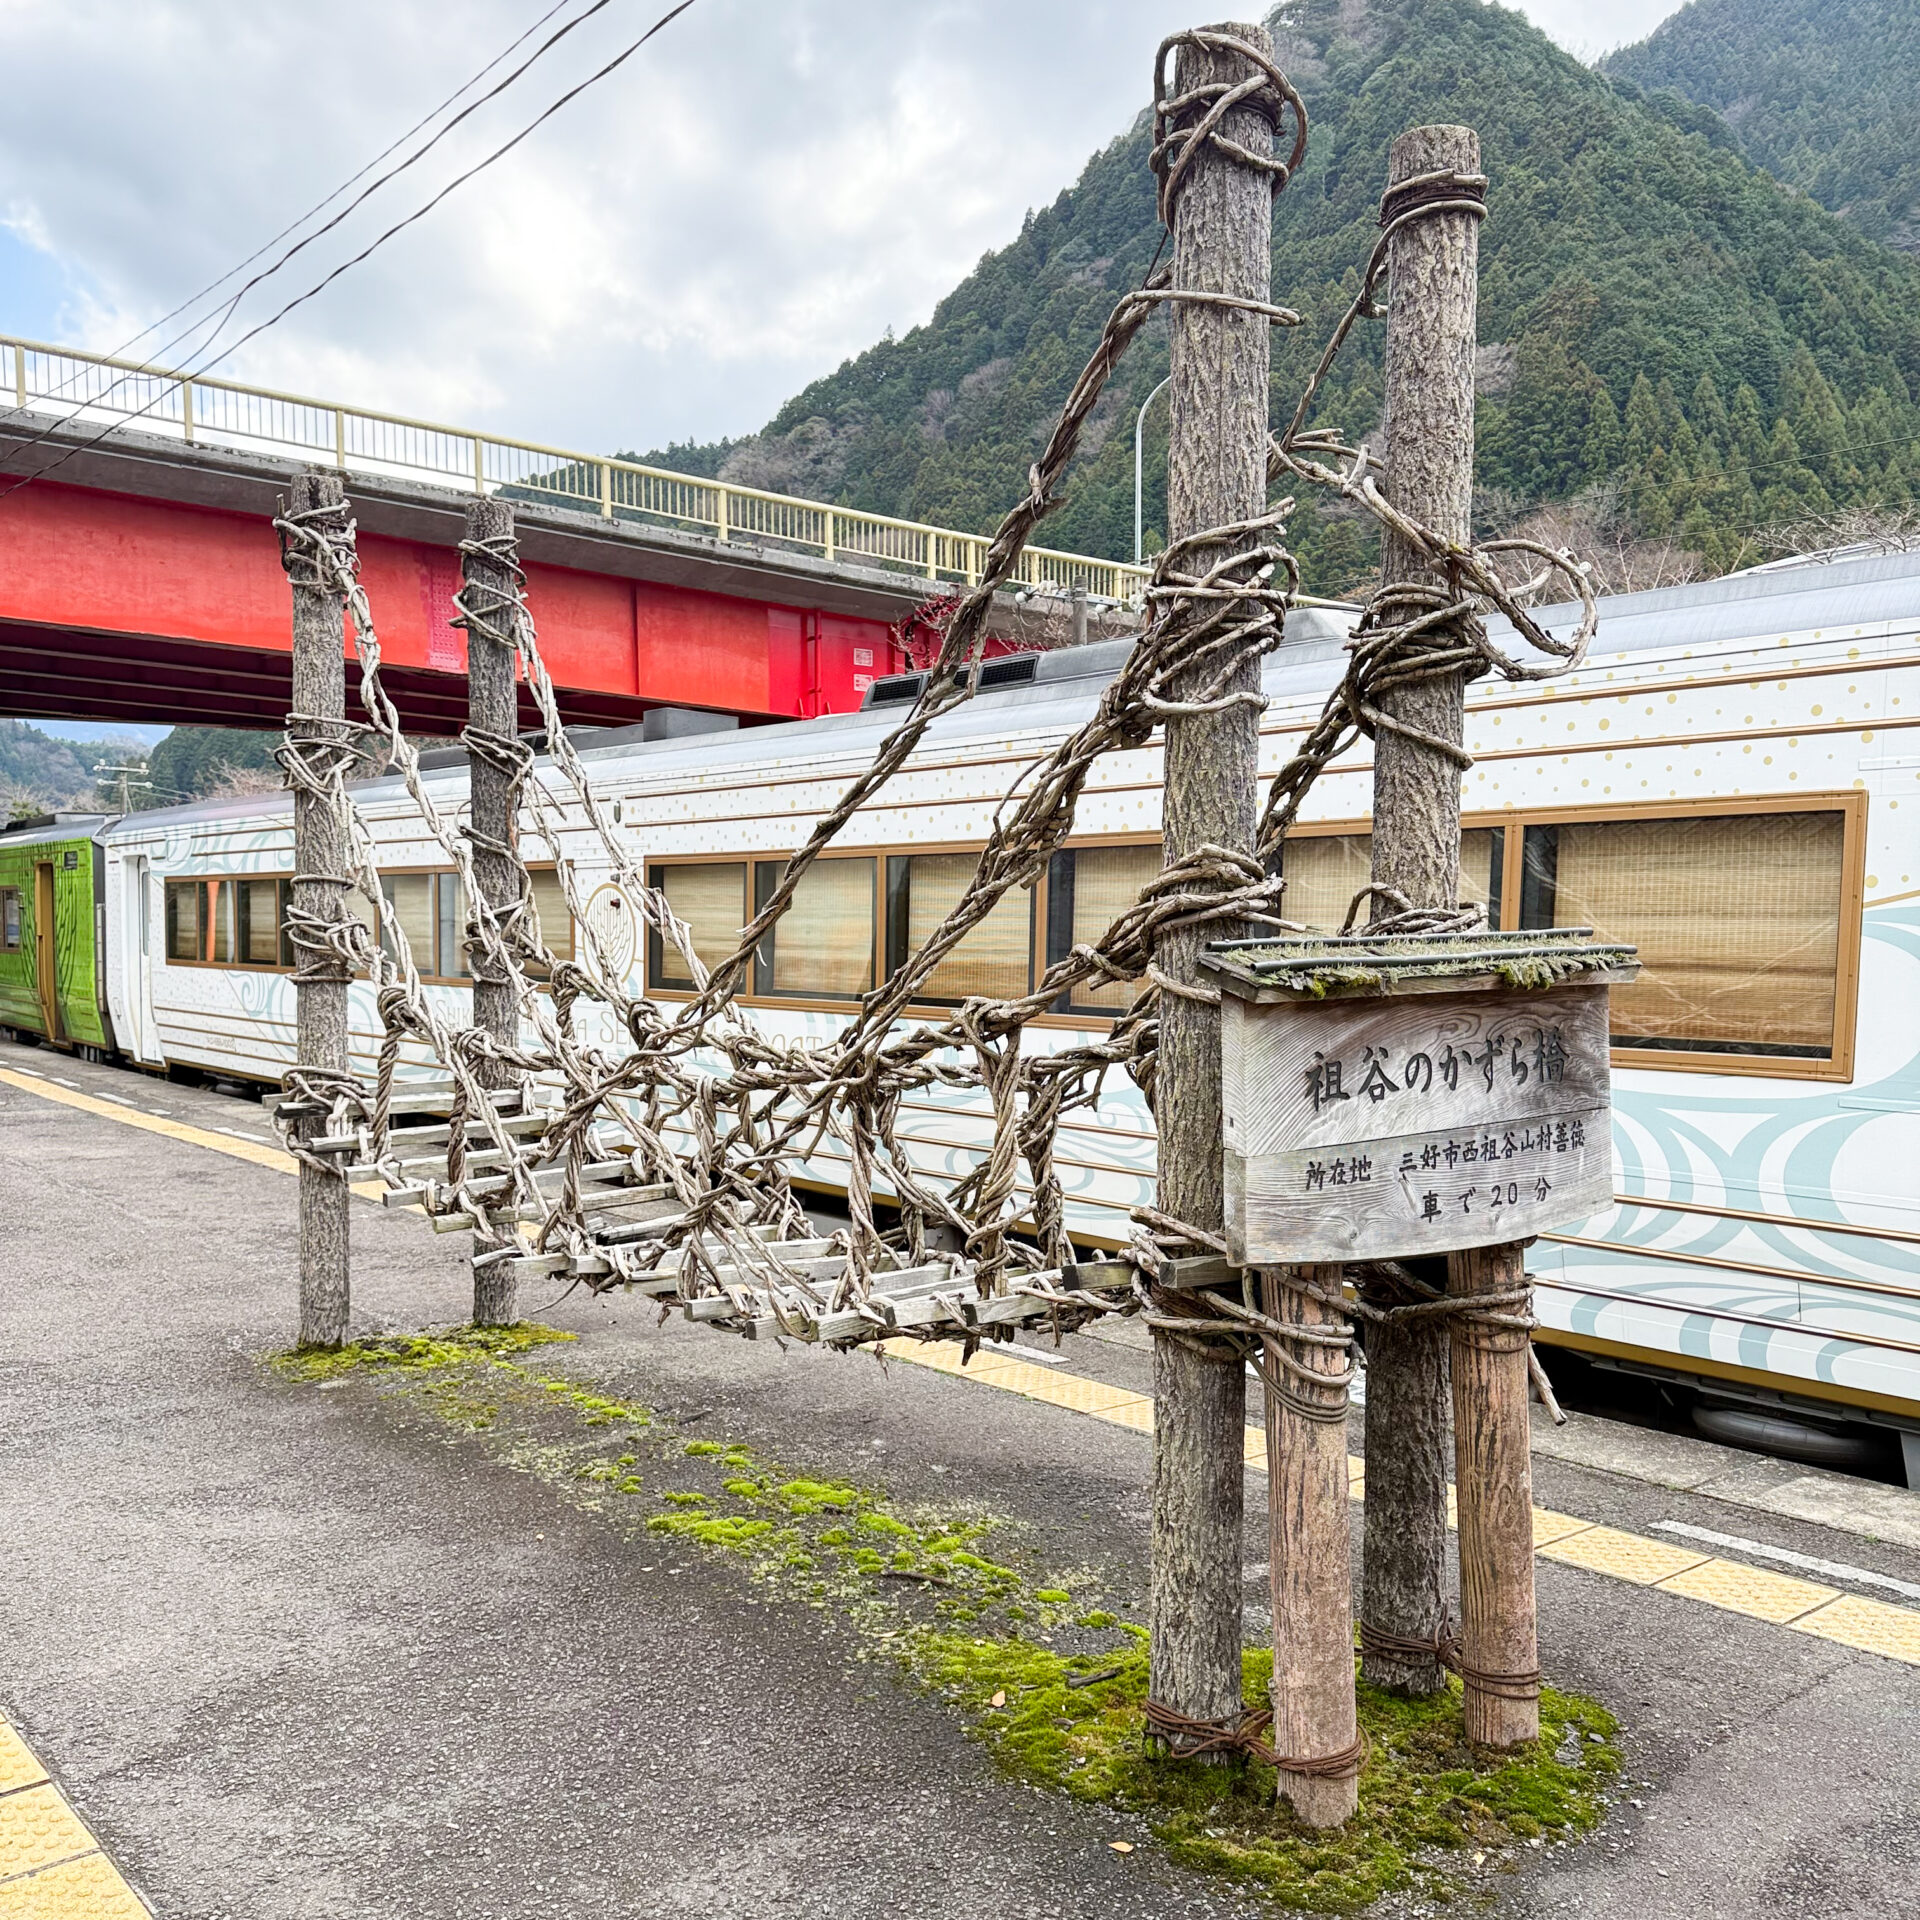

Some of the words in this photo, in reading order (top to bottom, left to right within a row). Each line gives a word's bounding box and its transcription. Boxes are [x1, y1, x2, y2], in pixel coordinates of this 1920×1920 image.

[1304, 1026, 1570, 1112] 祖谷のかずら橋
[1305, 1154, 1372, 1191] 所在地
